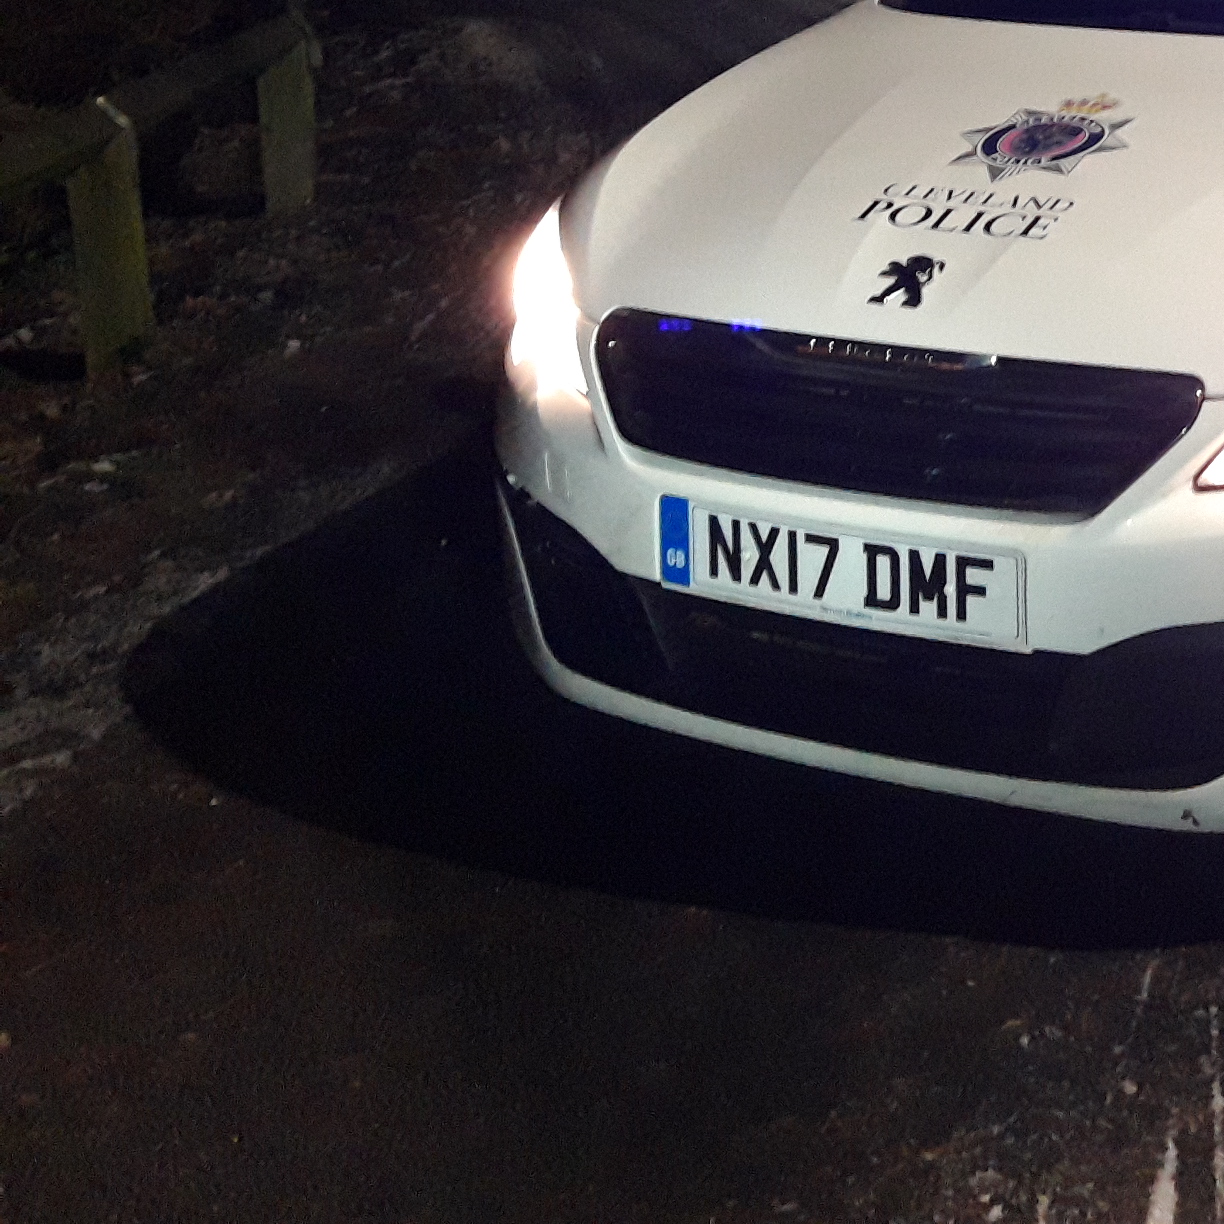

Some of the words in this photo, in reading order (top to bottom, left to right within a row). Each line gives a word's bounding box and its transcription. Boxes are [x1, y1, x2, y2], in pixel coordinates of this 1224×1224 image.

[883, 182, 1074, 212] CLEVELAND
[853, 198, 1060, 240] POLICE
[707, 514, 840, 600] NX17
[862, 542, 994, 622] DMF
